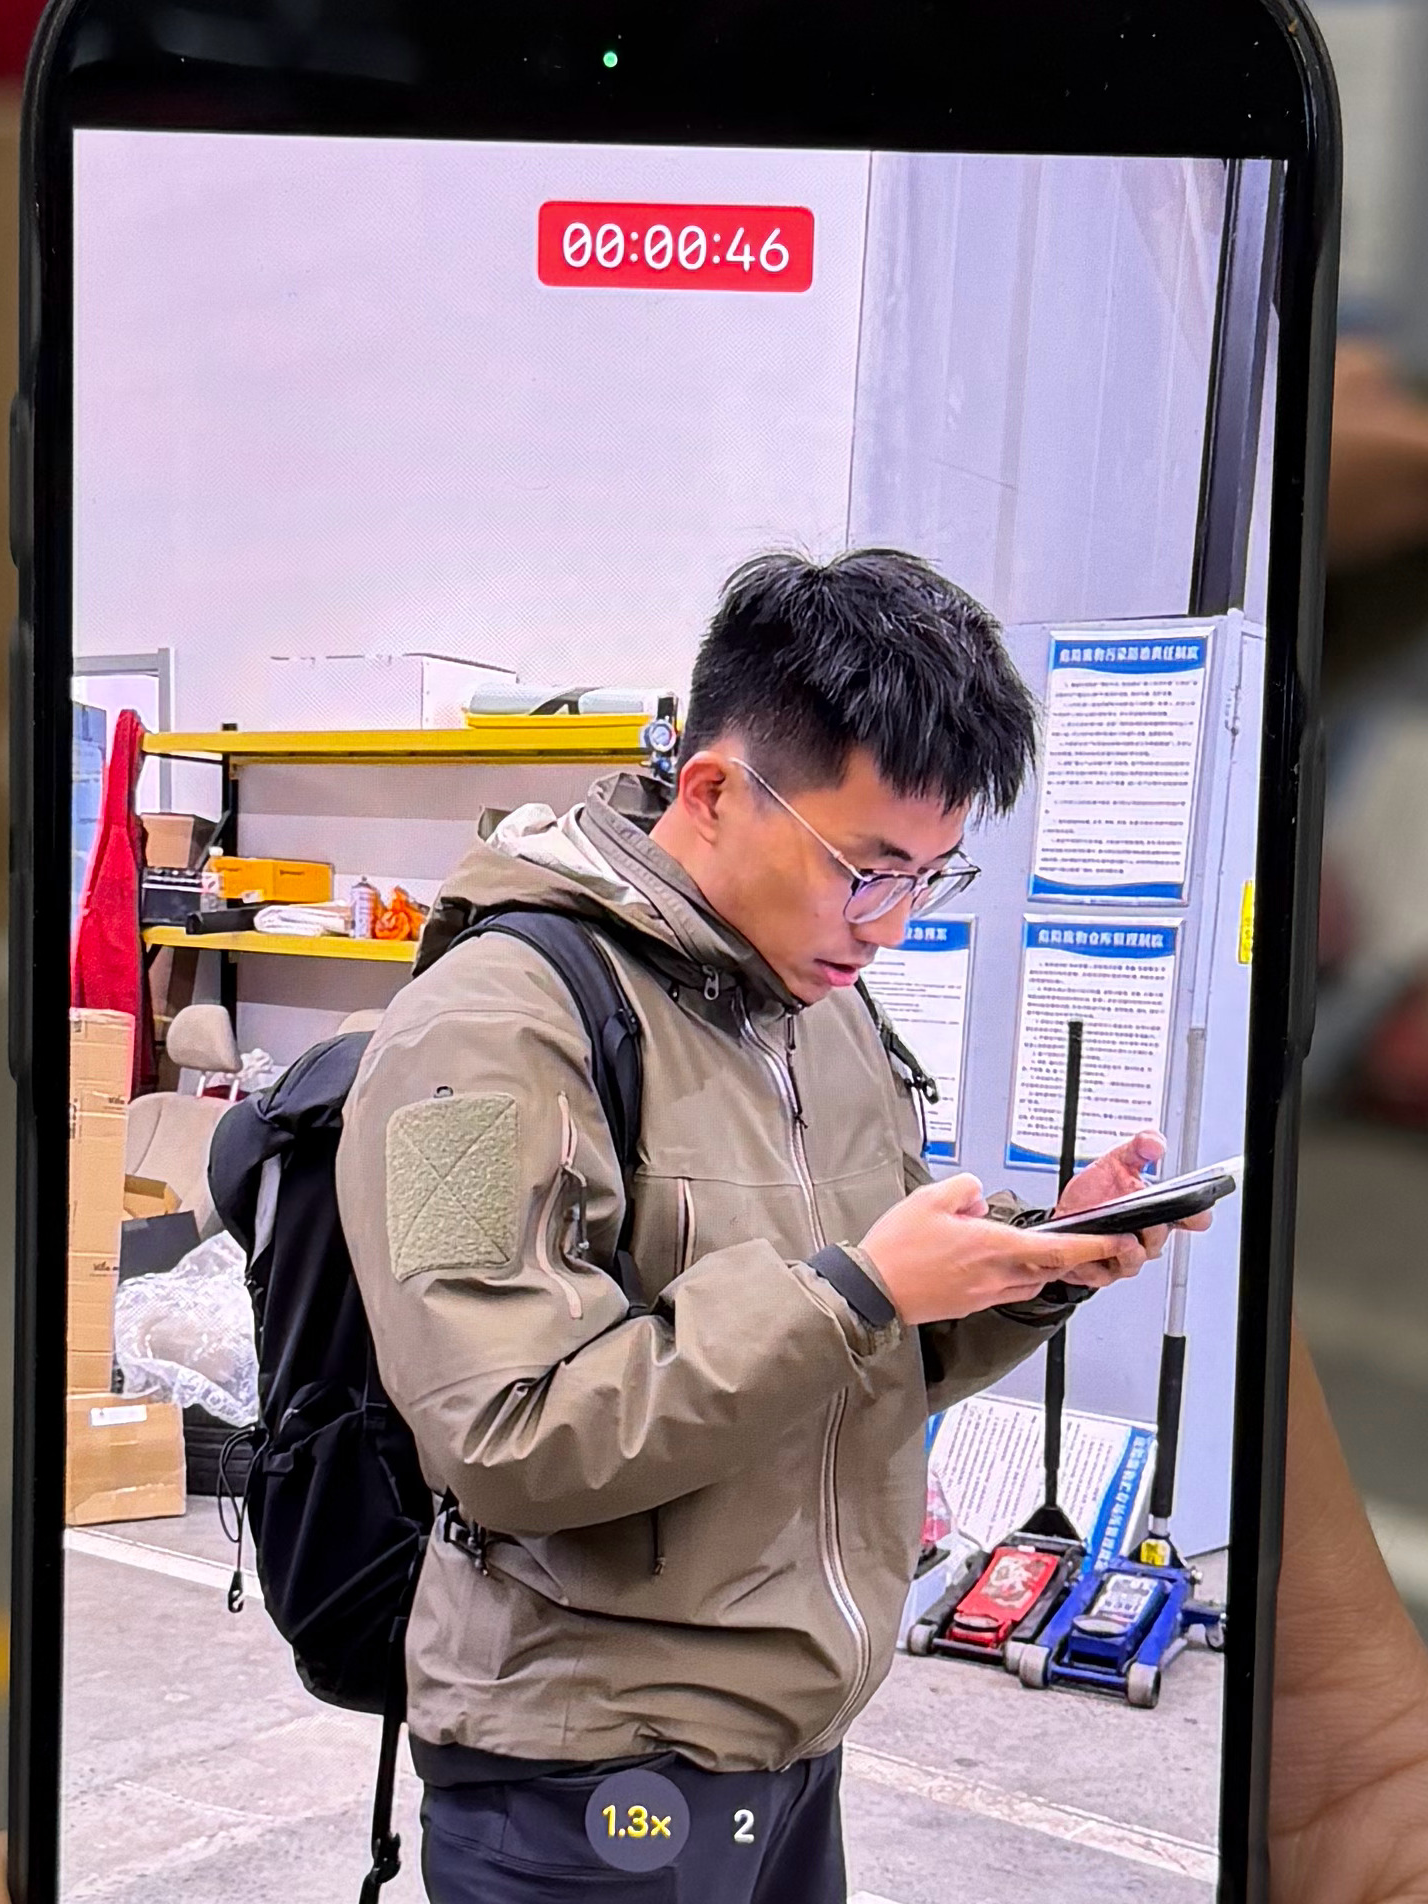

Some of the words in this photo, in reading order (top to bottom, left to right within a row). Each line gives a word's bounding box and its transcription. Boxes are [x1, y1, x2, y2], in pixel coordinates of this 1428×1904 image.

[562, 221, 790, 273] 00:00:46
[602, 1804, 672, 1838] 1.3x
[733, 1809, 755, 1843] 2
